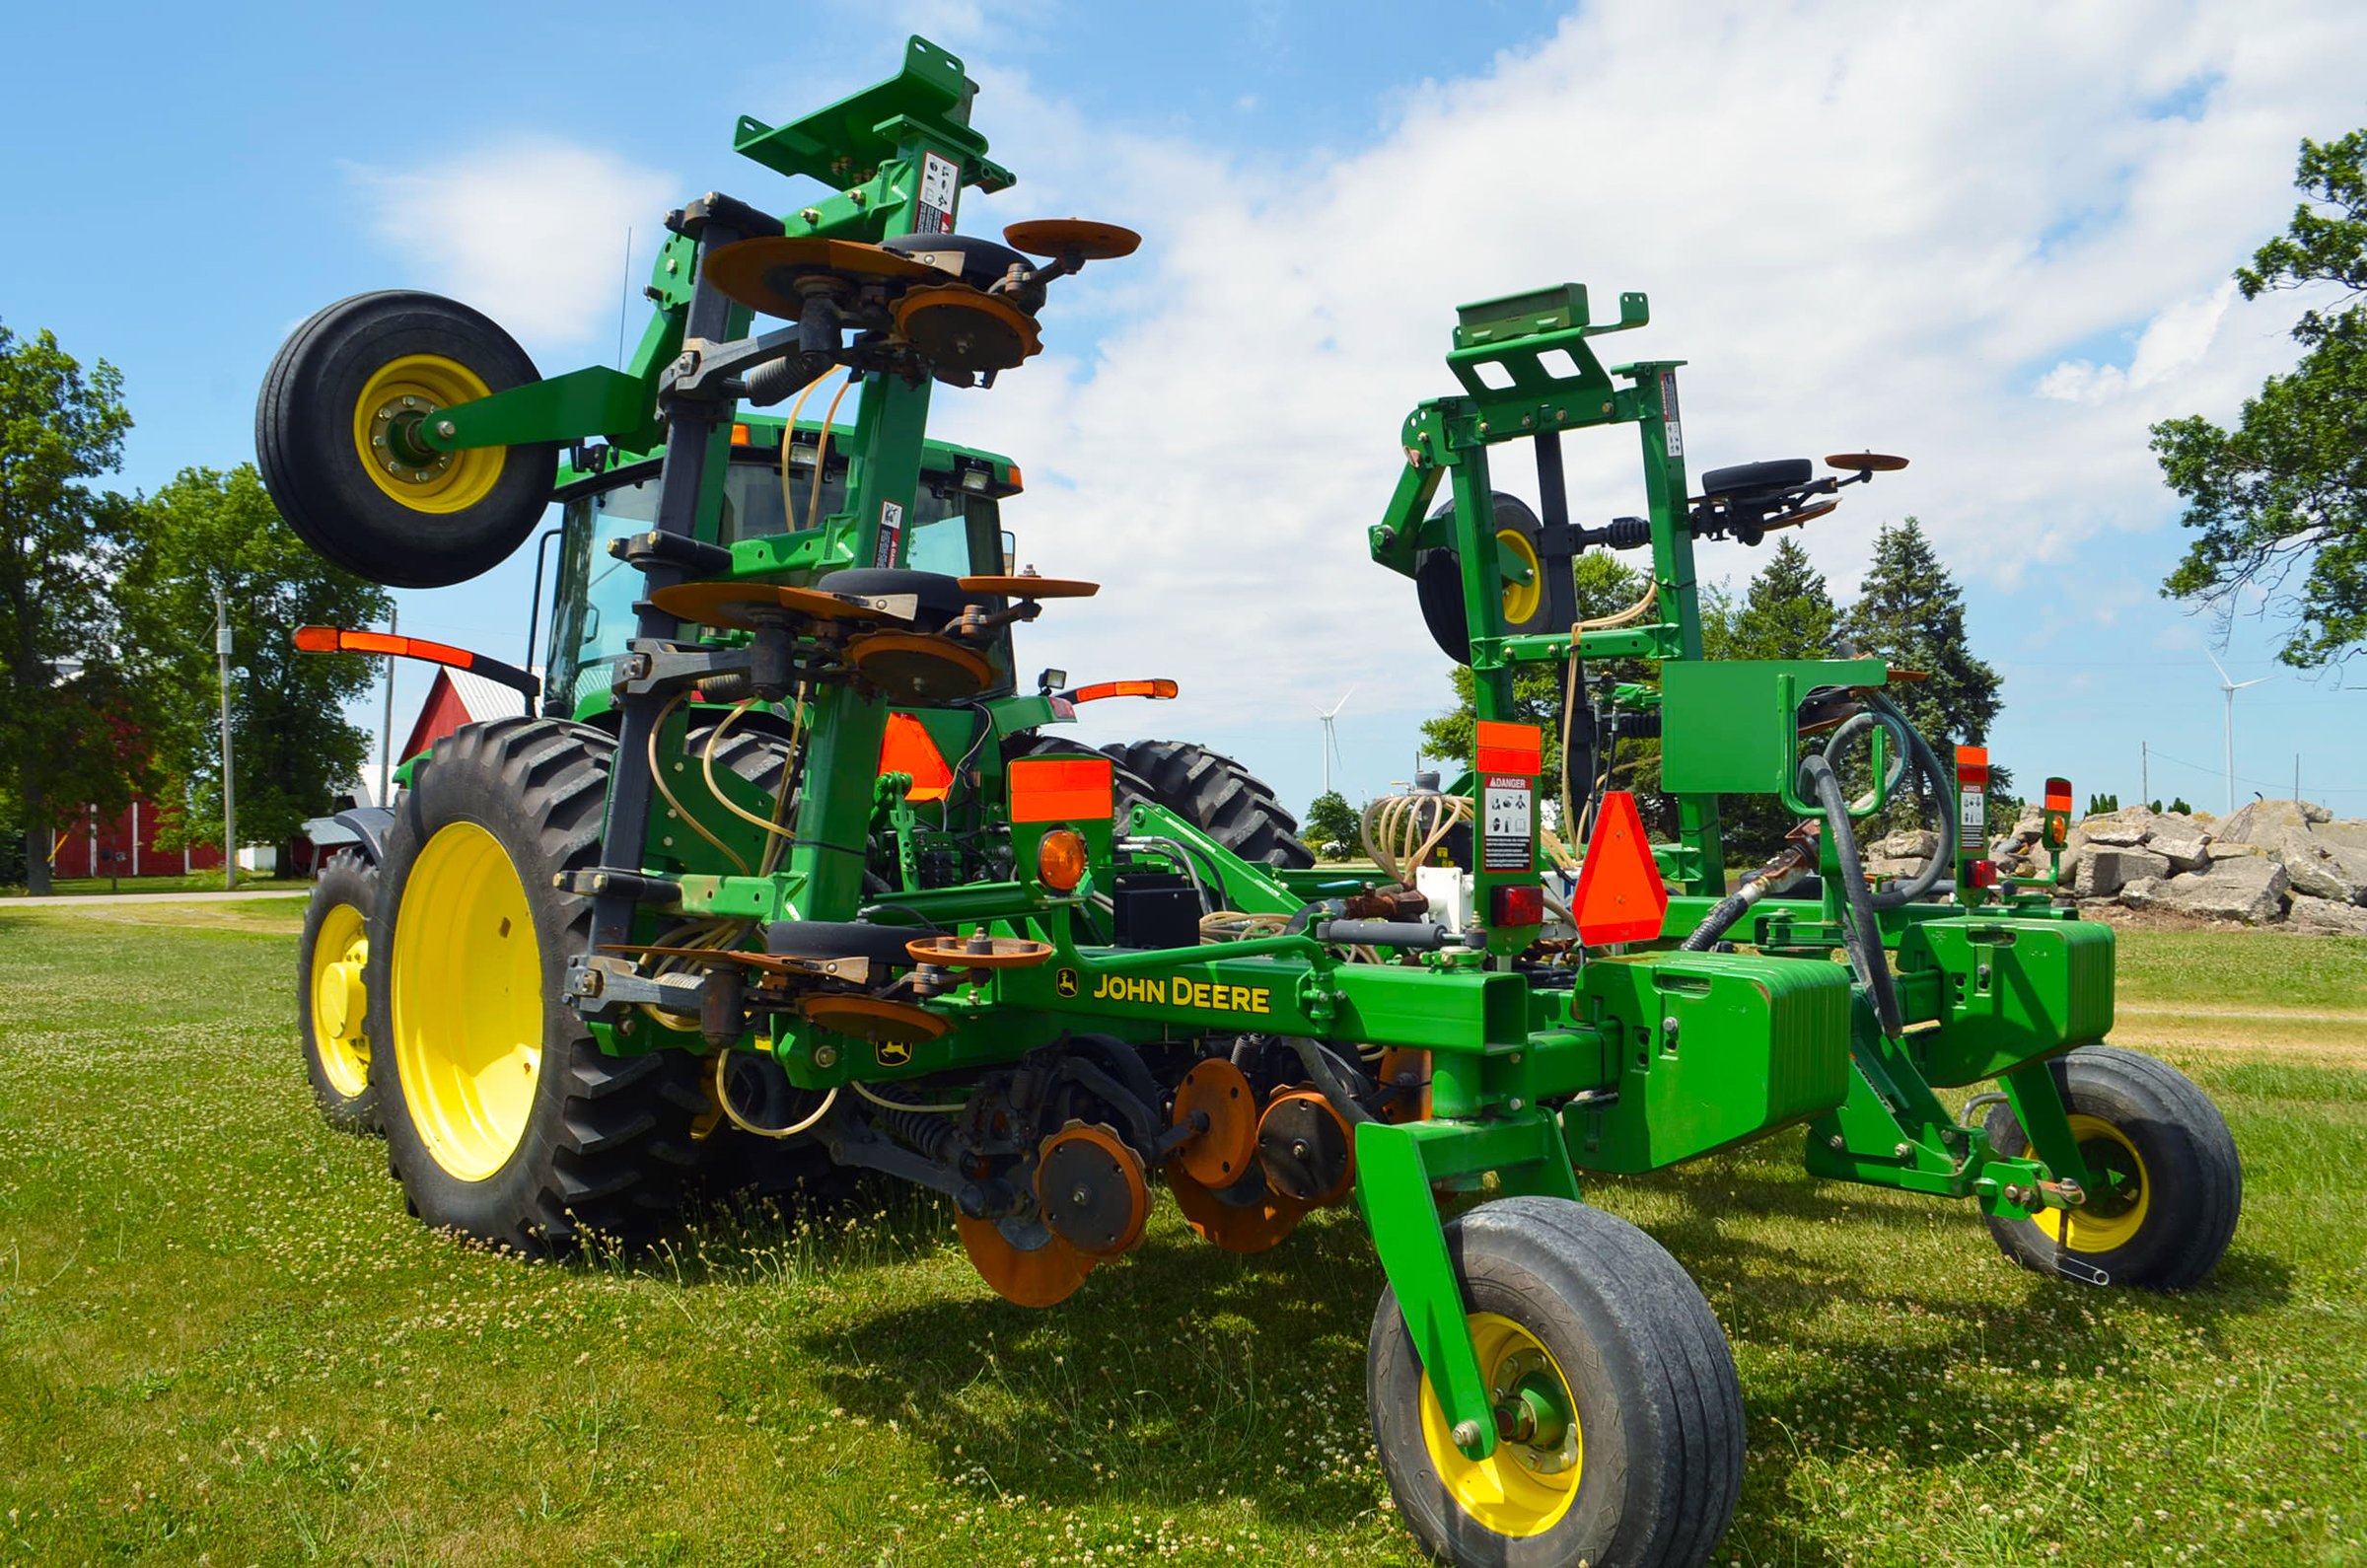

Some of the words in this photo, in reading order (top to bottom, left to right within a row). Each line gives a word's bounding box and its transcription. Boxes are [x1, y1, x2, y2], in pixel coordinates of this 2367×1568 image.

[1495, 777, 1526, 788] DANGER
[1094, 973, 1165, 1004] JOHN
[1171, 976, 1270, 1014] DEERE
